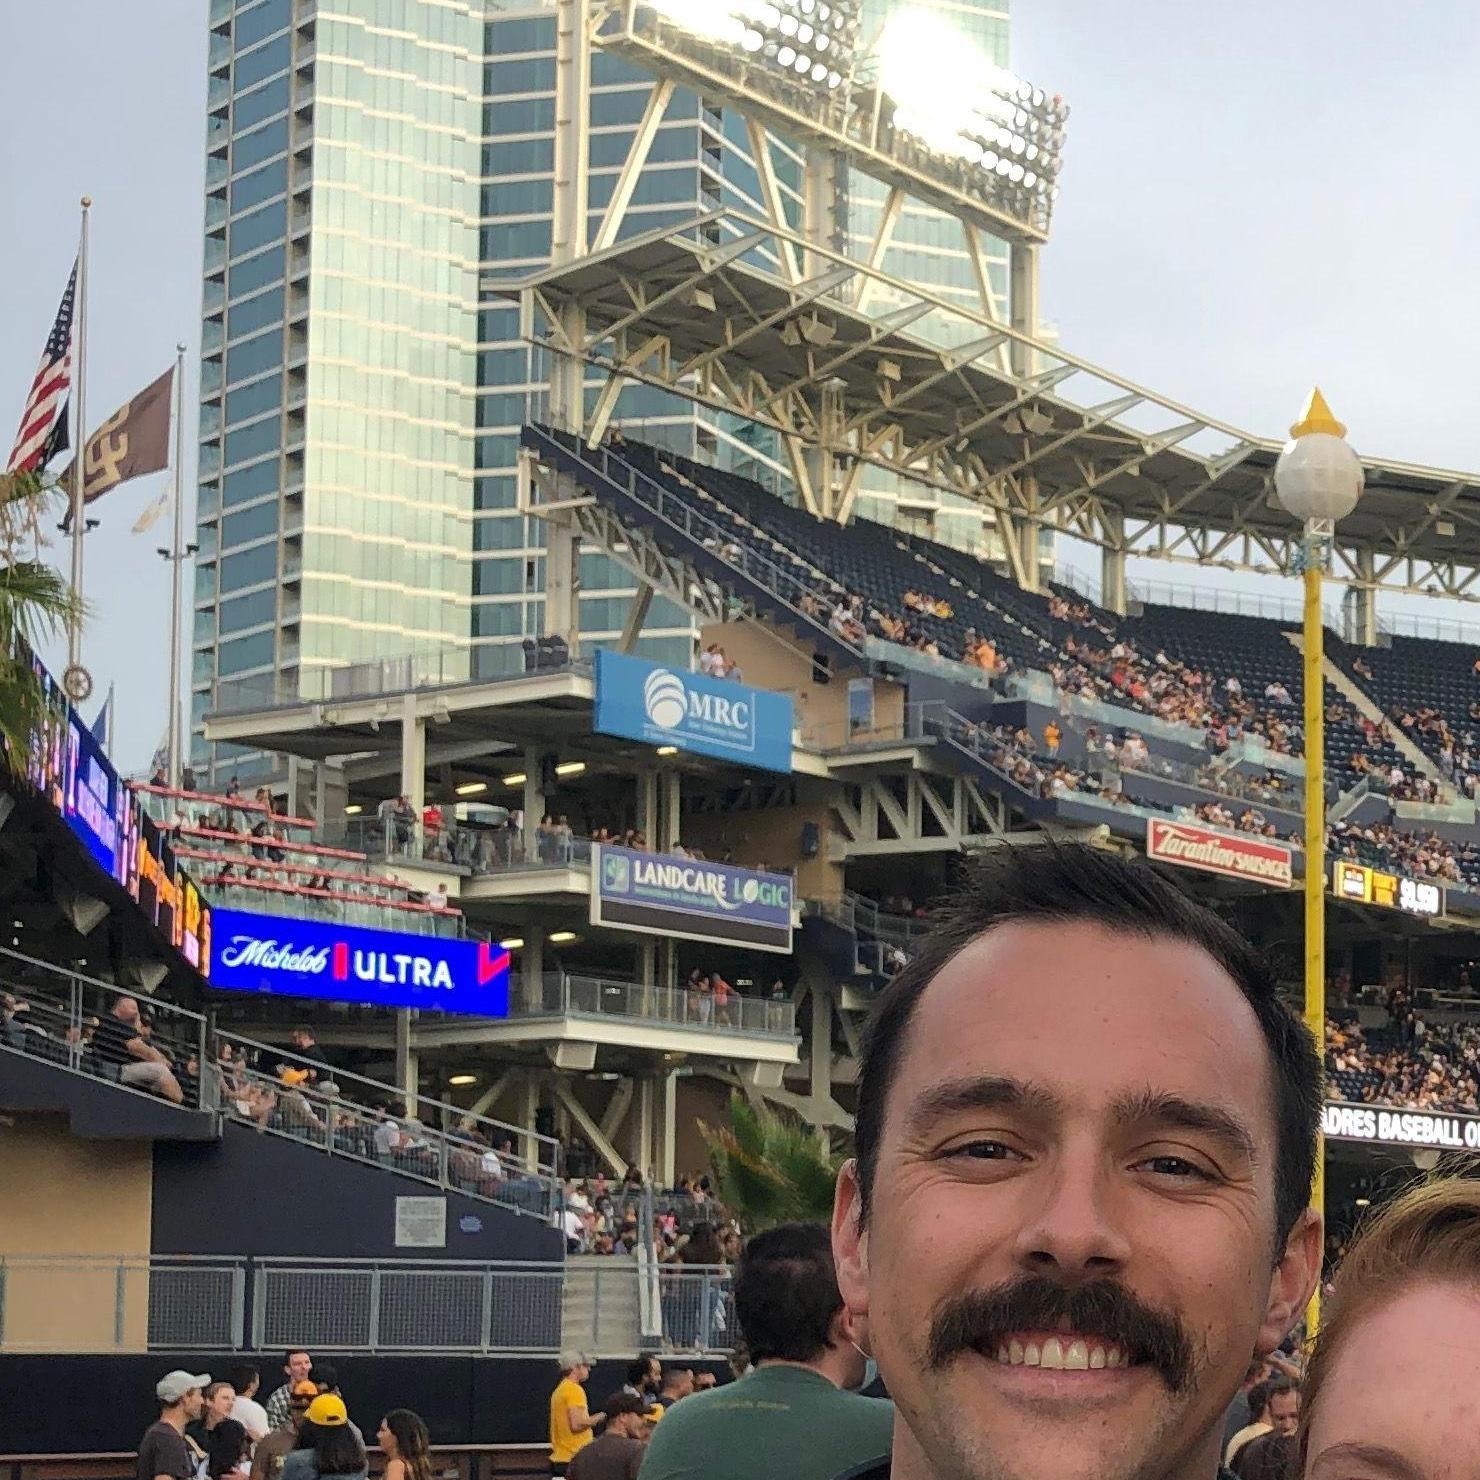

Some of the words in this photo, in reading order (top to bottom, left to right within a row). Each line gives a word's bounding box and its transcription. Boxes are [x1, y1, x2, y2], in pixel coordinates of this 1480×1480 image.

[688, 690, 748, 729] MRC
[1157, 825, 1236, 868] Tarantino
[634, 859, 734, 899] LANDCARE
[734, 877, 789, 908] LOGIC
[221, 936, 331, 974] Michelob
[354, 950, 452, 989] ULTRA
[1322, 1106, 1376, 1138] ADRES
[1378, 1112, 1463, 1147] BASEBALL
